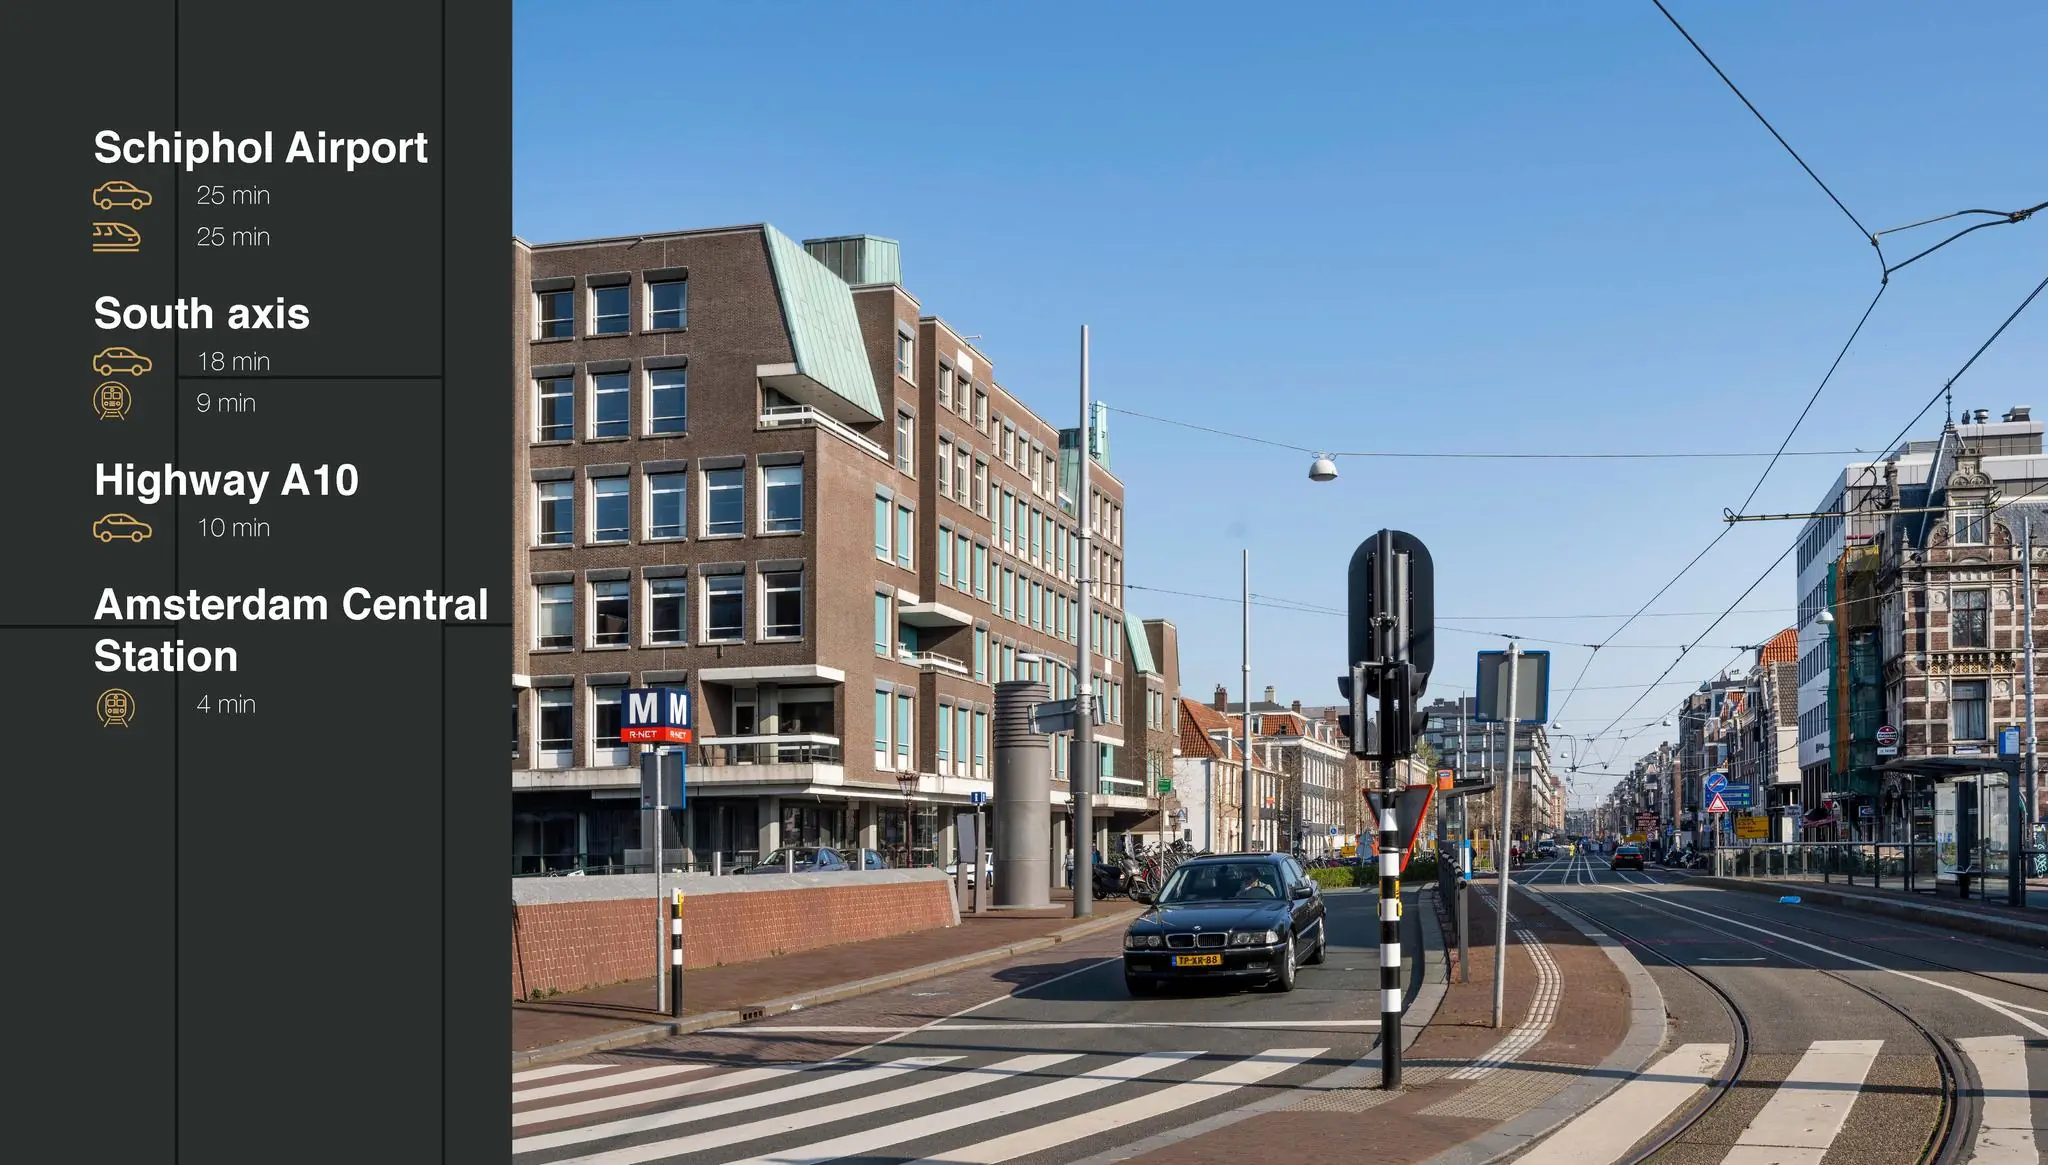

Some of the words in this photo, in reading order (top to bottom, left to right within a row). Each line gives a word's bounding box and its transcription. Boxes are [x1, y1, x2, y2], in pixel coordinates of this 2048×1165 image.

[629, 692, 658, 725] M
[669, 692, 687, 725] M
[629, 730, 658, 739] R-NET
[1179, 956, 1218, 965] TP-XR-88
